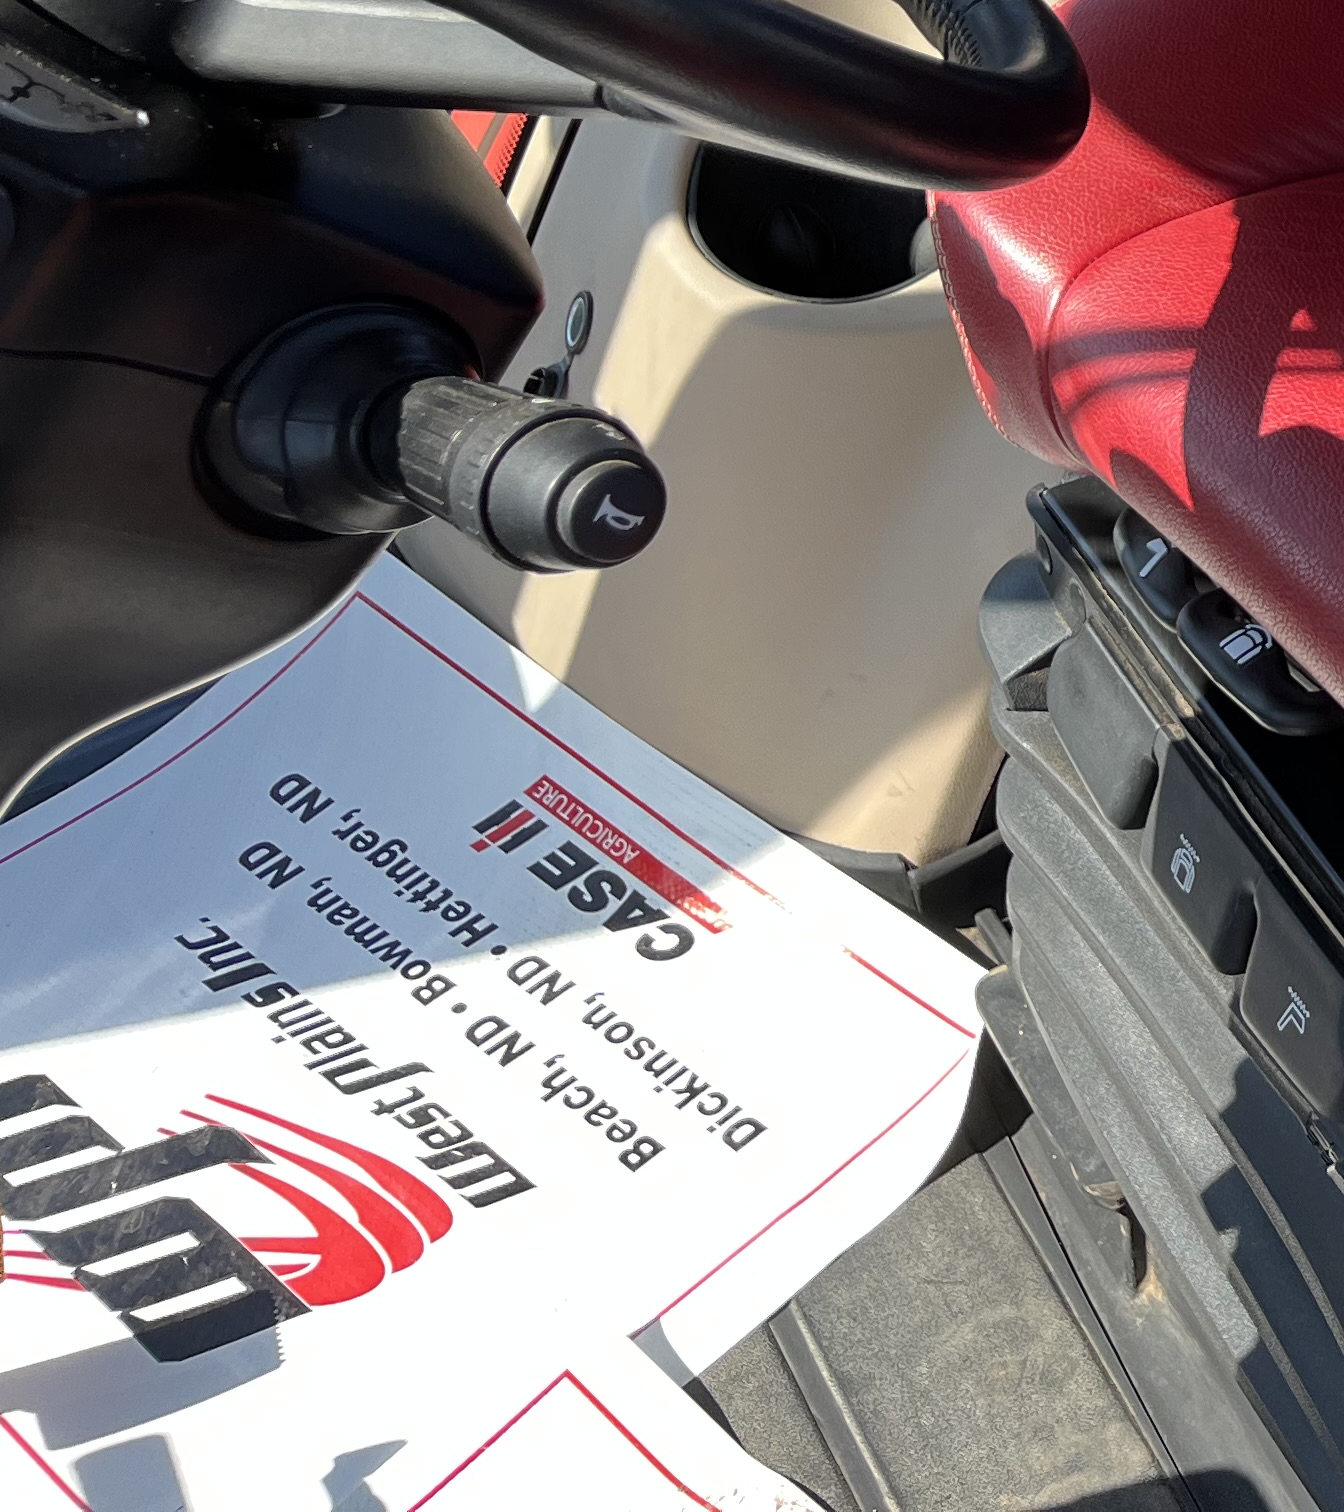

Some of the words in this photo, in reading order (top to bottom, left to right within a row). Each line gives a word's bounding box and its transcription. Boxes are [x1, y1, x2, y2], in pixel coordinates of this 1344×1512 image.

[269, 772, 336, 824] ND
[532, 780, 640, 864] AGRICULTURE
[238, 840, 306, 890] ND
[331, 808, 499, 948] Hettinger,
[526, 840, 695, 962] CASE
[174, 916, 278, 993] Inc.
[306, 876, 457, 1006] Bowman,
[506, 955, 577, 1006] ND
[465, 1014, 537, 1068] ND
[581, 992, 769, 1152] Dickinson,
[370, 1086, 538, 1210] West
[540, 1053, 667, 1172] Beach,
